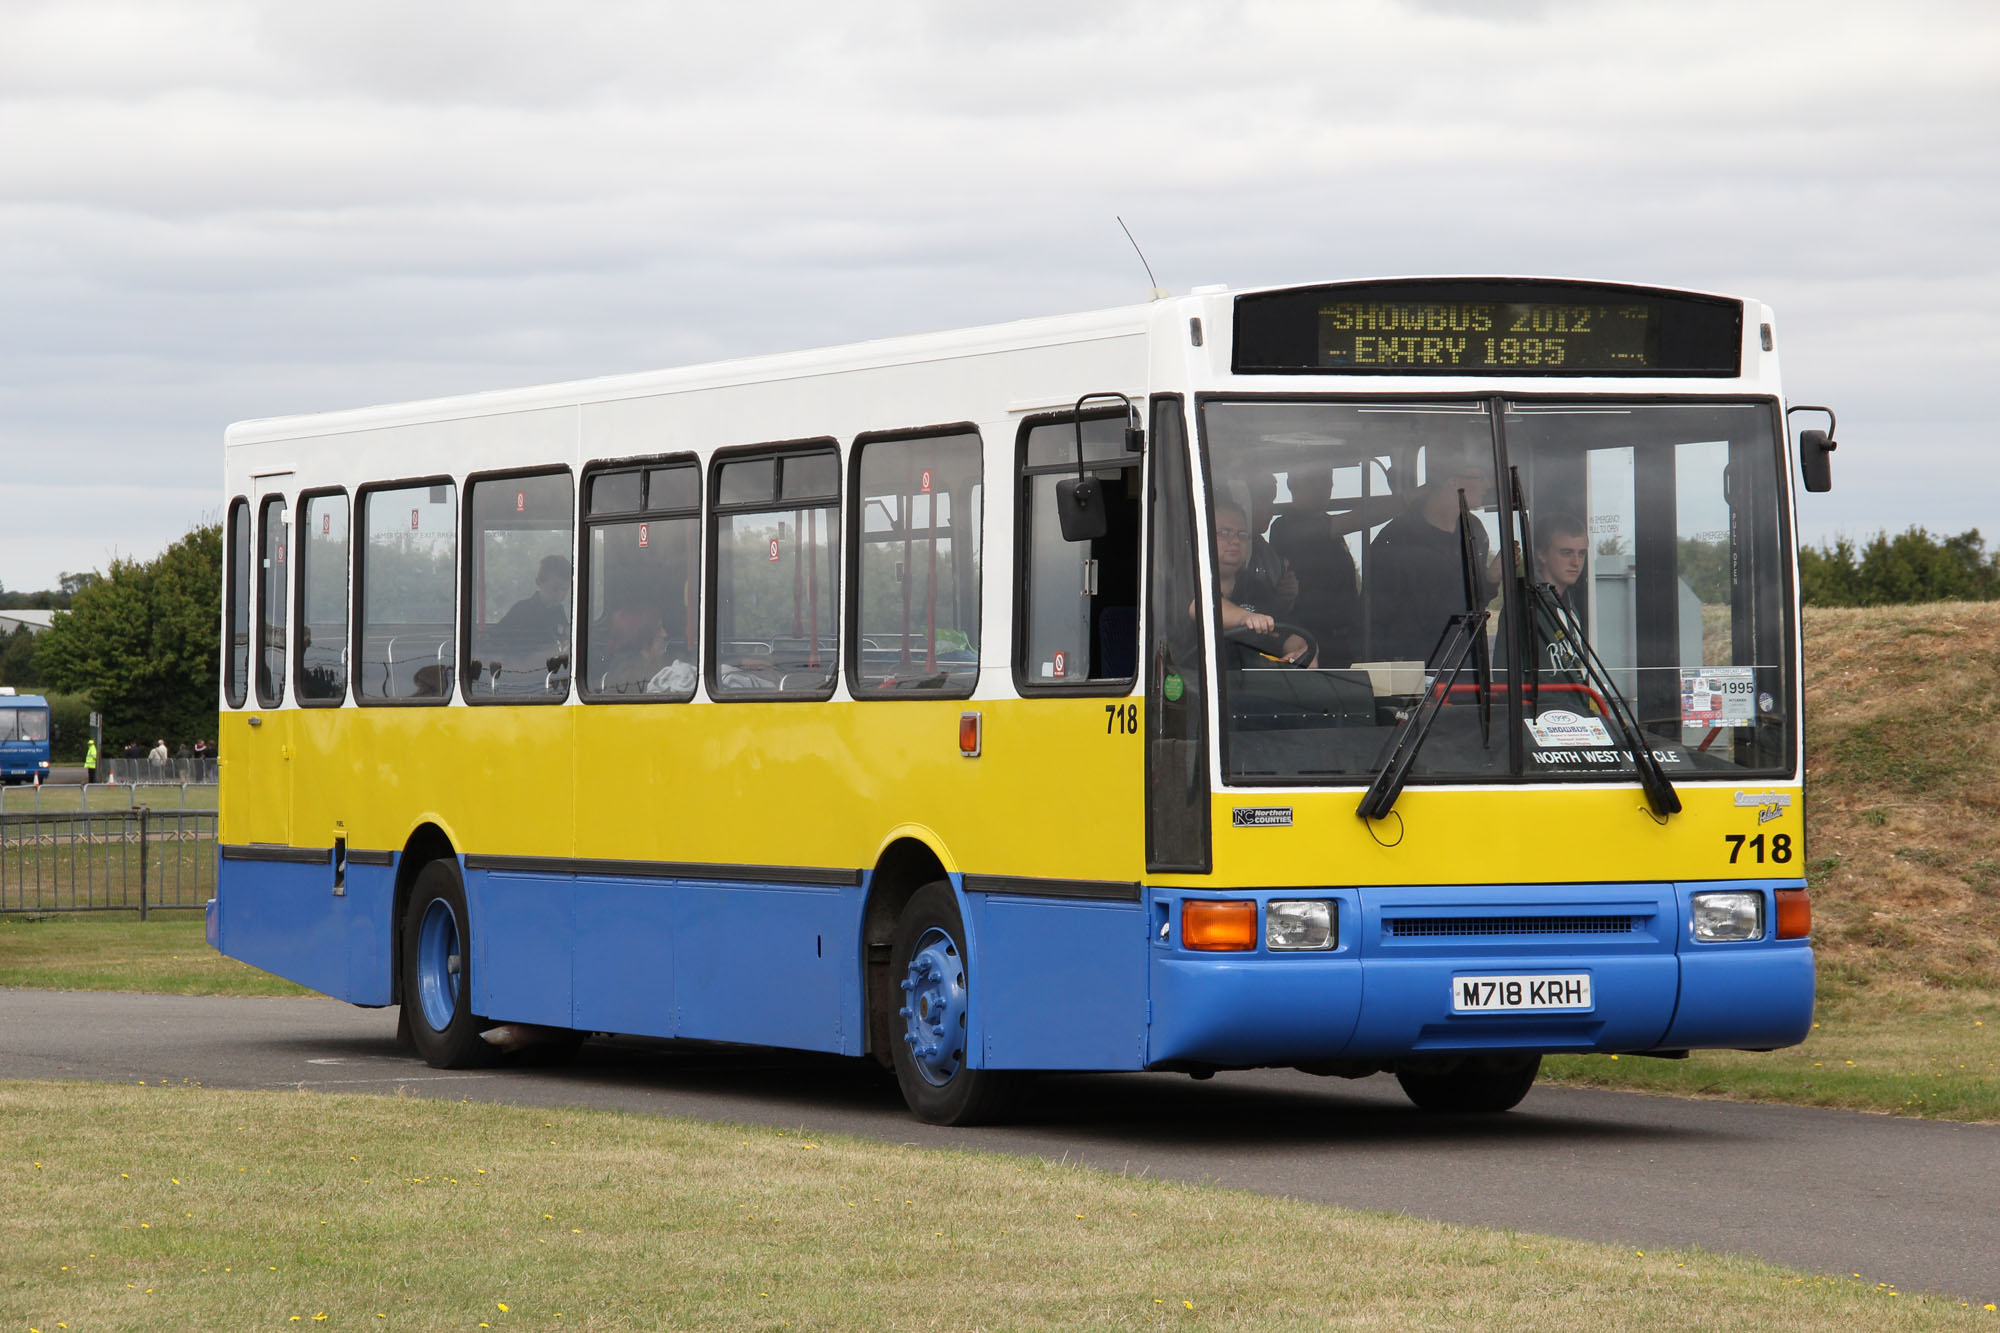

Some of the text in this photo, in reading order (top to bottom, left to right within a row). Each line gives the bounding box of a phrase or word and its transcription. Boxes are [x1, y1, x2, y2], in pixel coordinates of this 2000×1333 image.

[1333, 304, 1591, 333] SHOWBUS 2012
[1354, 336, 1566, 365] ENTRY 1995
[1721, 682, 1754, 694] 1995
[1105, 704, 1138, 734] 718
[1532, 751, 1581, 764] NORTH
[1581, 750, 1621, 763] WEST
[1725, 833, 1793, 864] 718
[1463, 980, 1582, 1006] M718 KRH
